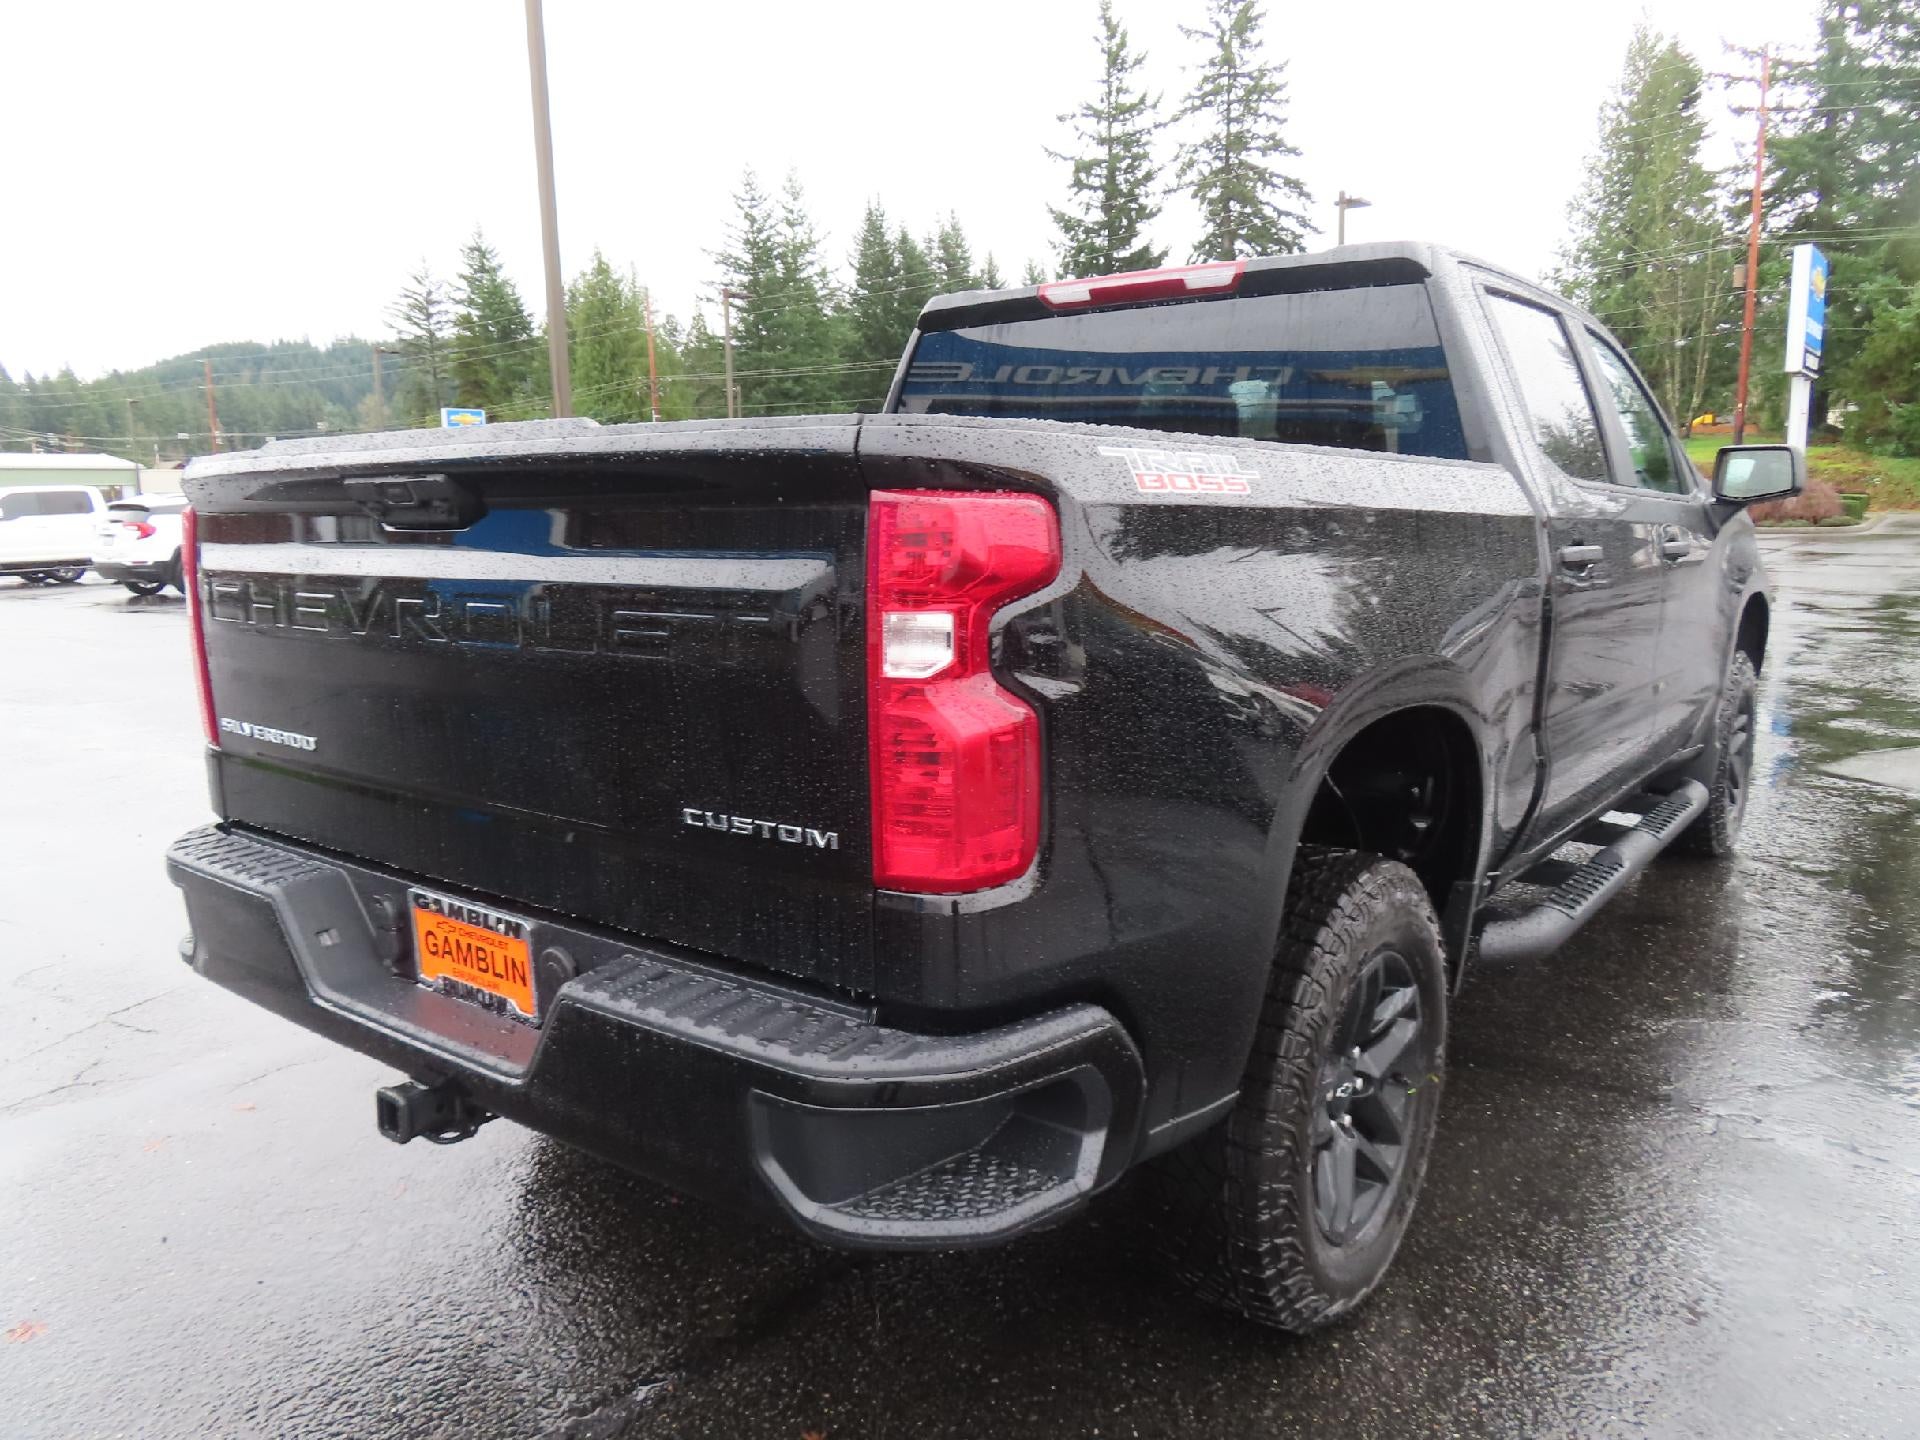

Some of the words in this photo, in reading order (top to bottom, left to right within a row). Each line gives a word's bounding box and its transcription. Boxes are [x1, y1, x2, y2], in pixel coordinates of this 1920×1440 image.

[1098, 446, 1260, 478] TRAIL
[1136, 472, 1251, 494] BOSS
[208, 581, 772, 667] CHEVROLET
[220, 717, 318, 752] SILVERADO
[677, 807, 839, 850] CUSTOM
[425, 930, 527, 987] GAMBLIN
